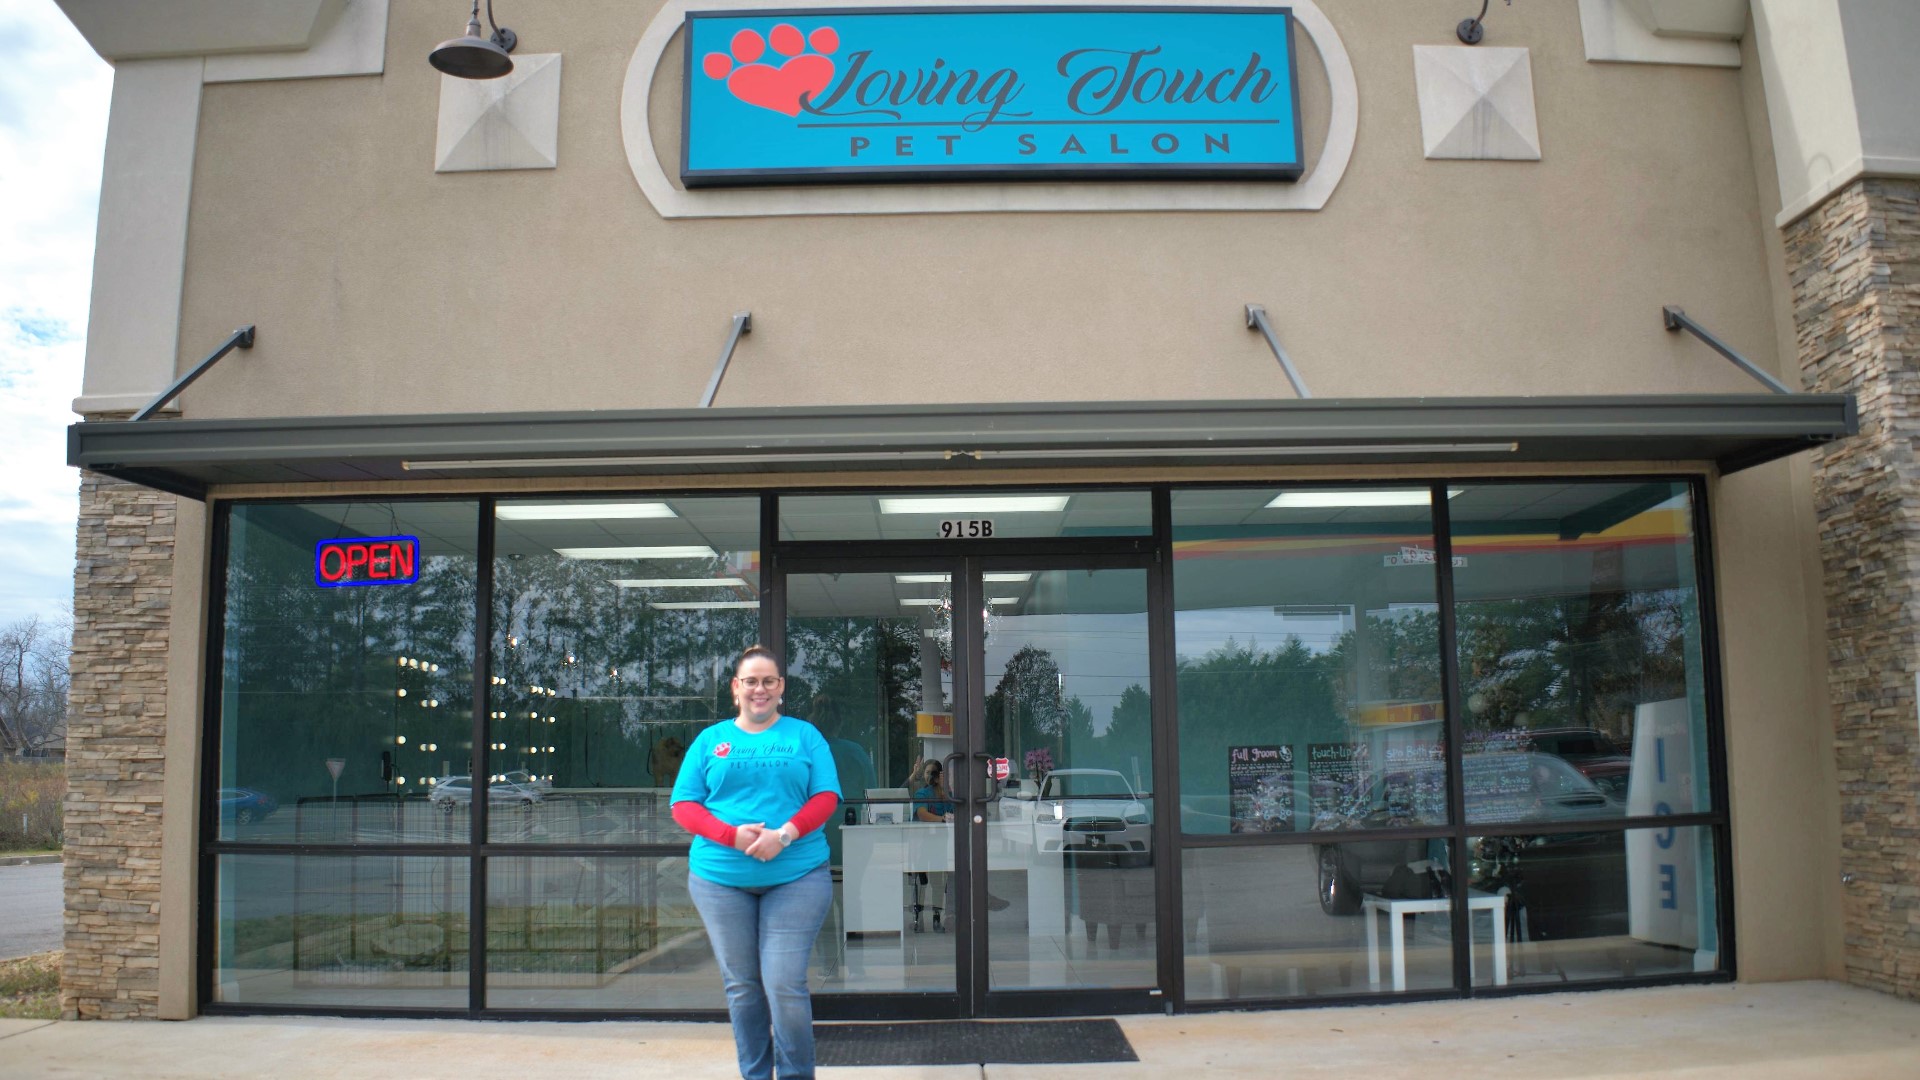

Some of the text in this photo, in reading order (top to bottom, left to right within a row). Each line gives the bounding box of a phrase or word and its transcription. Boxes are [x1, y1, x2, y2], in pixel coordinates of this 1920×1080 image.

[799, 45, 1278, 132] Loving Touch
[850, 132, 1230, 157] PET SALON
[941, 520, 993, 538] 915B
[320, 543, 413, 580] OPEN
[731, 760, 789, 769] PET SALON
[1232, 748, 1249, 764] full
